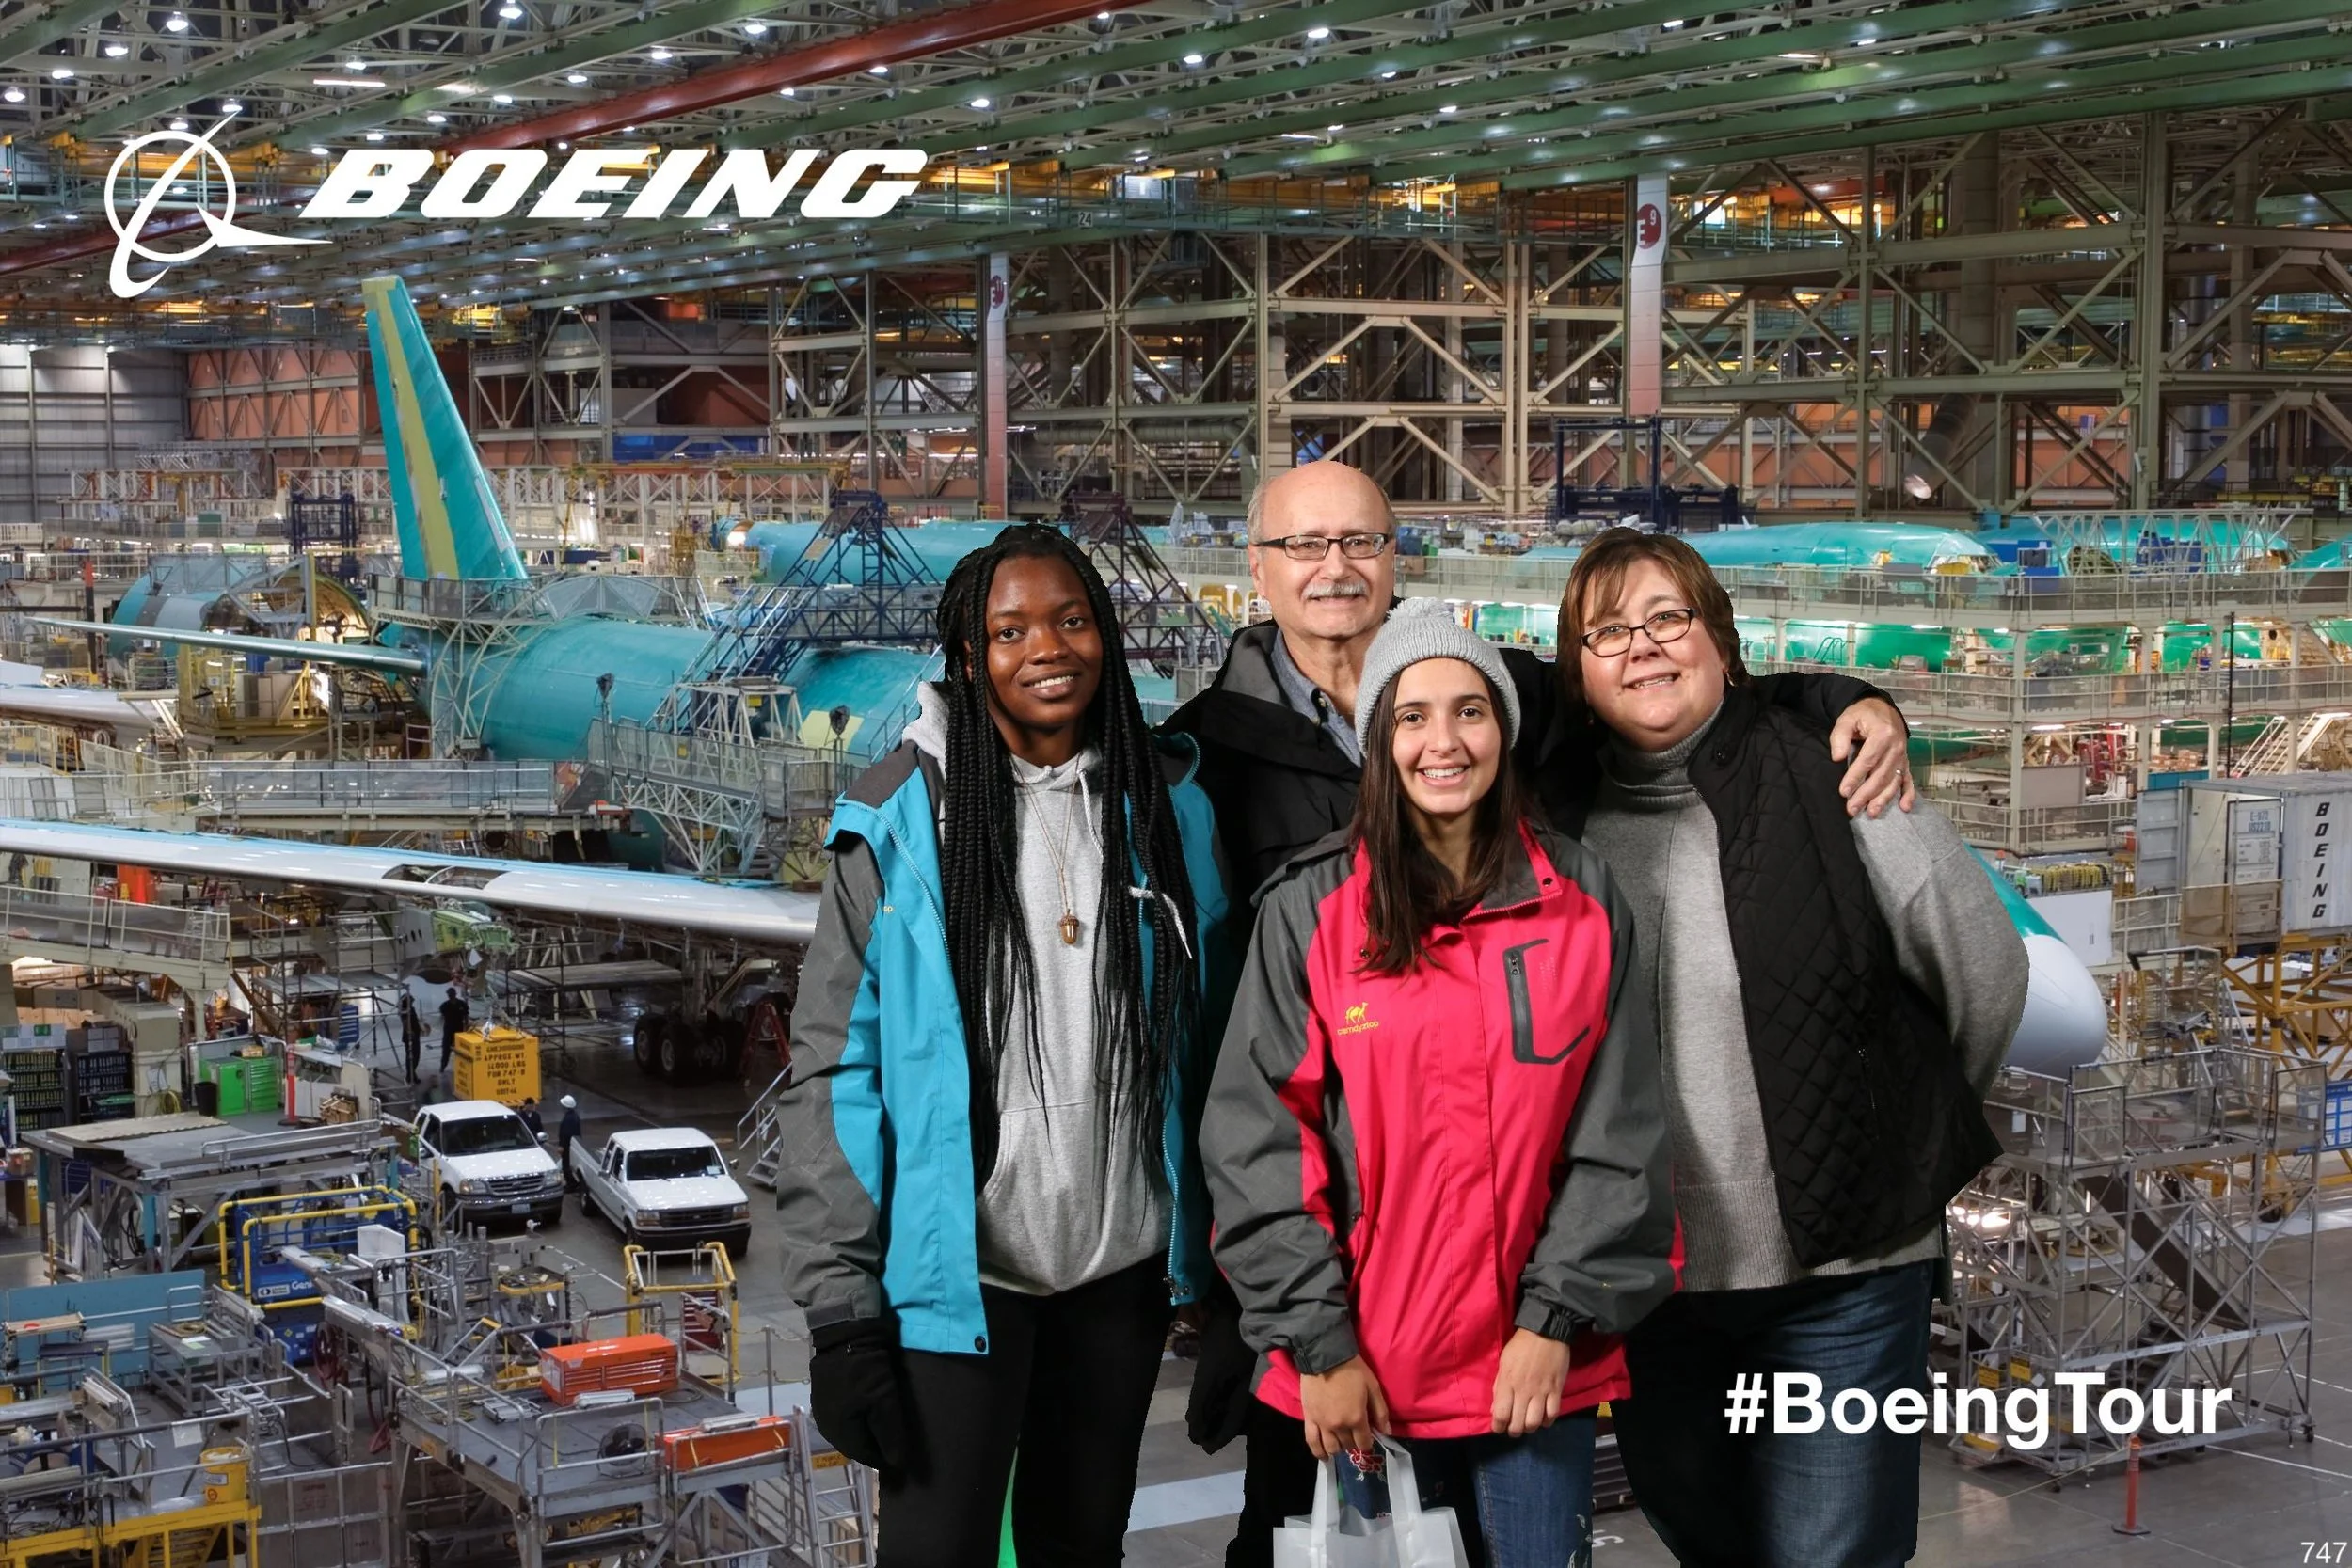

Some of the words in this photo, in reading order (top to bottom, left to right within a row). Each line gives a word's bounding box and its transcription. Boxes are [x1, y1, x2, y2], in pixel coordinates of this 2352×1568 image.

[1079, 212, 1091, 226] 24
[2312, 802, 2330, 918] BOEING
[292, 1280, 313, 1290] Geni
